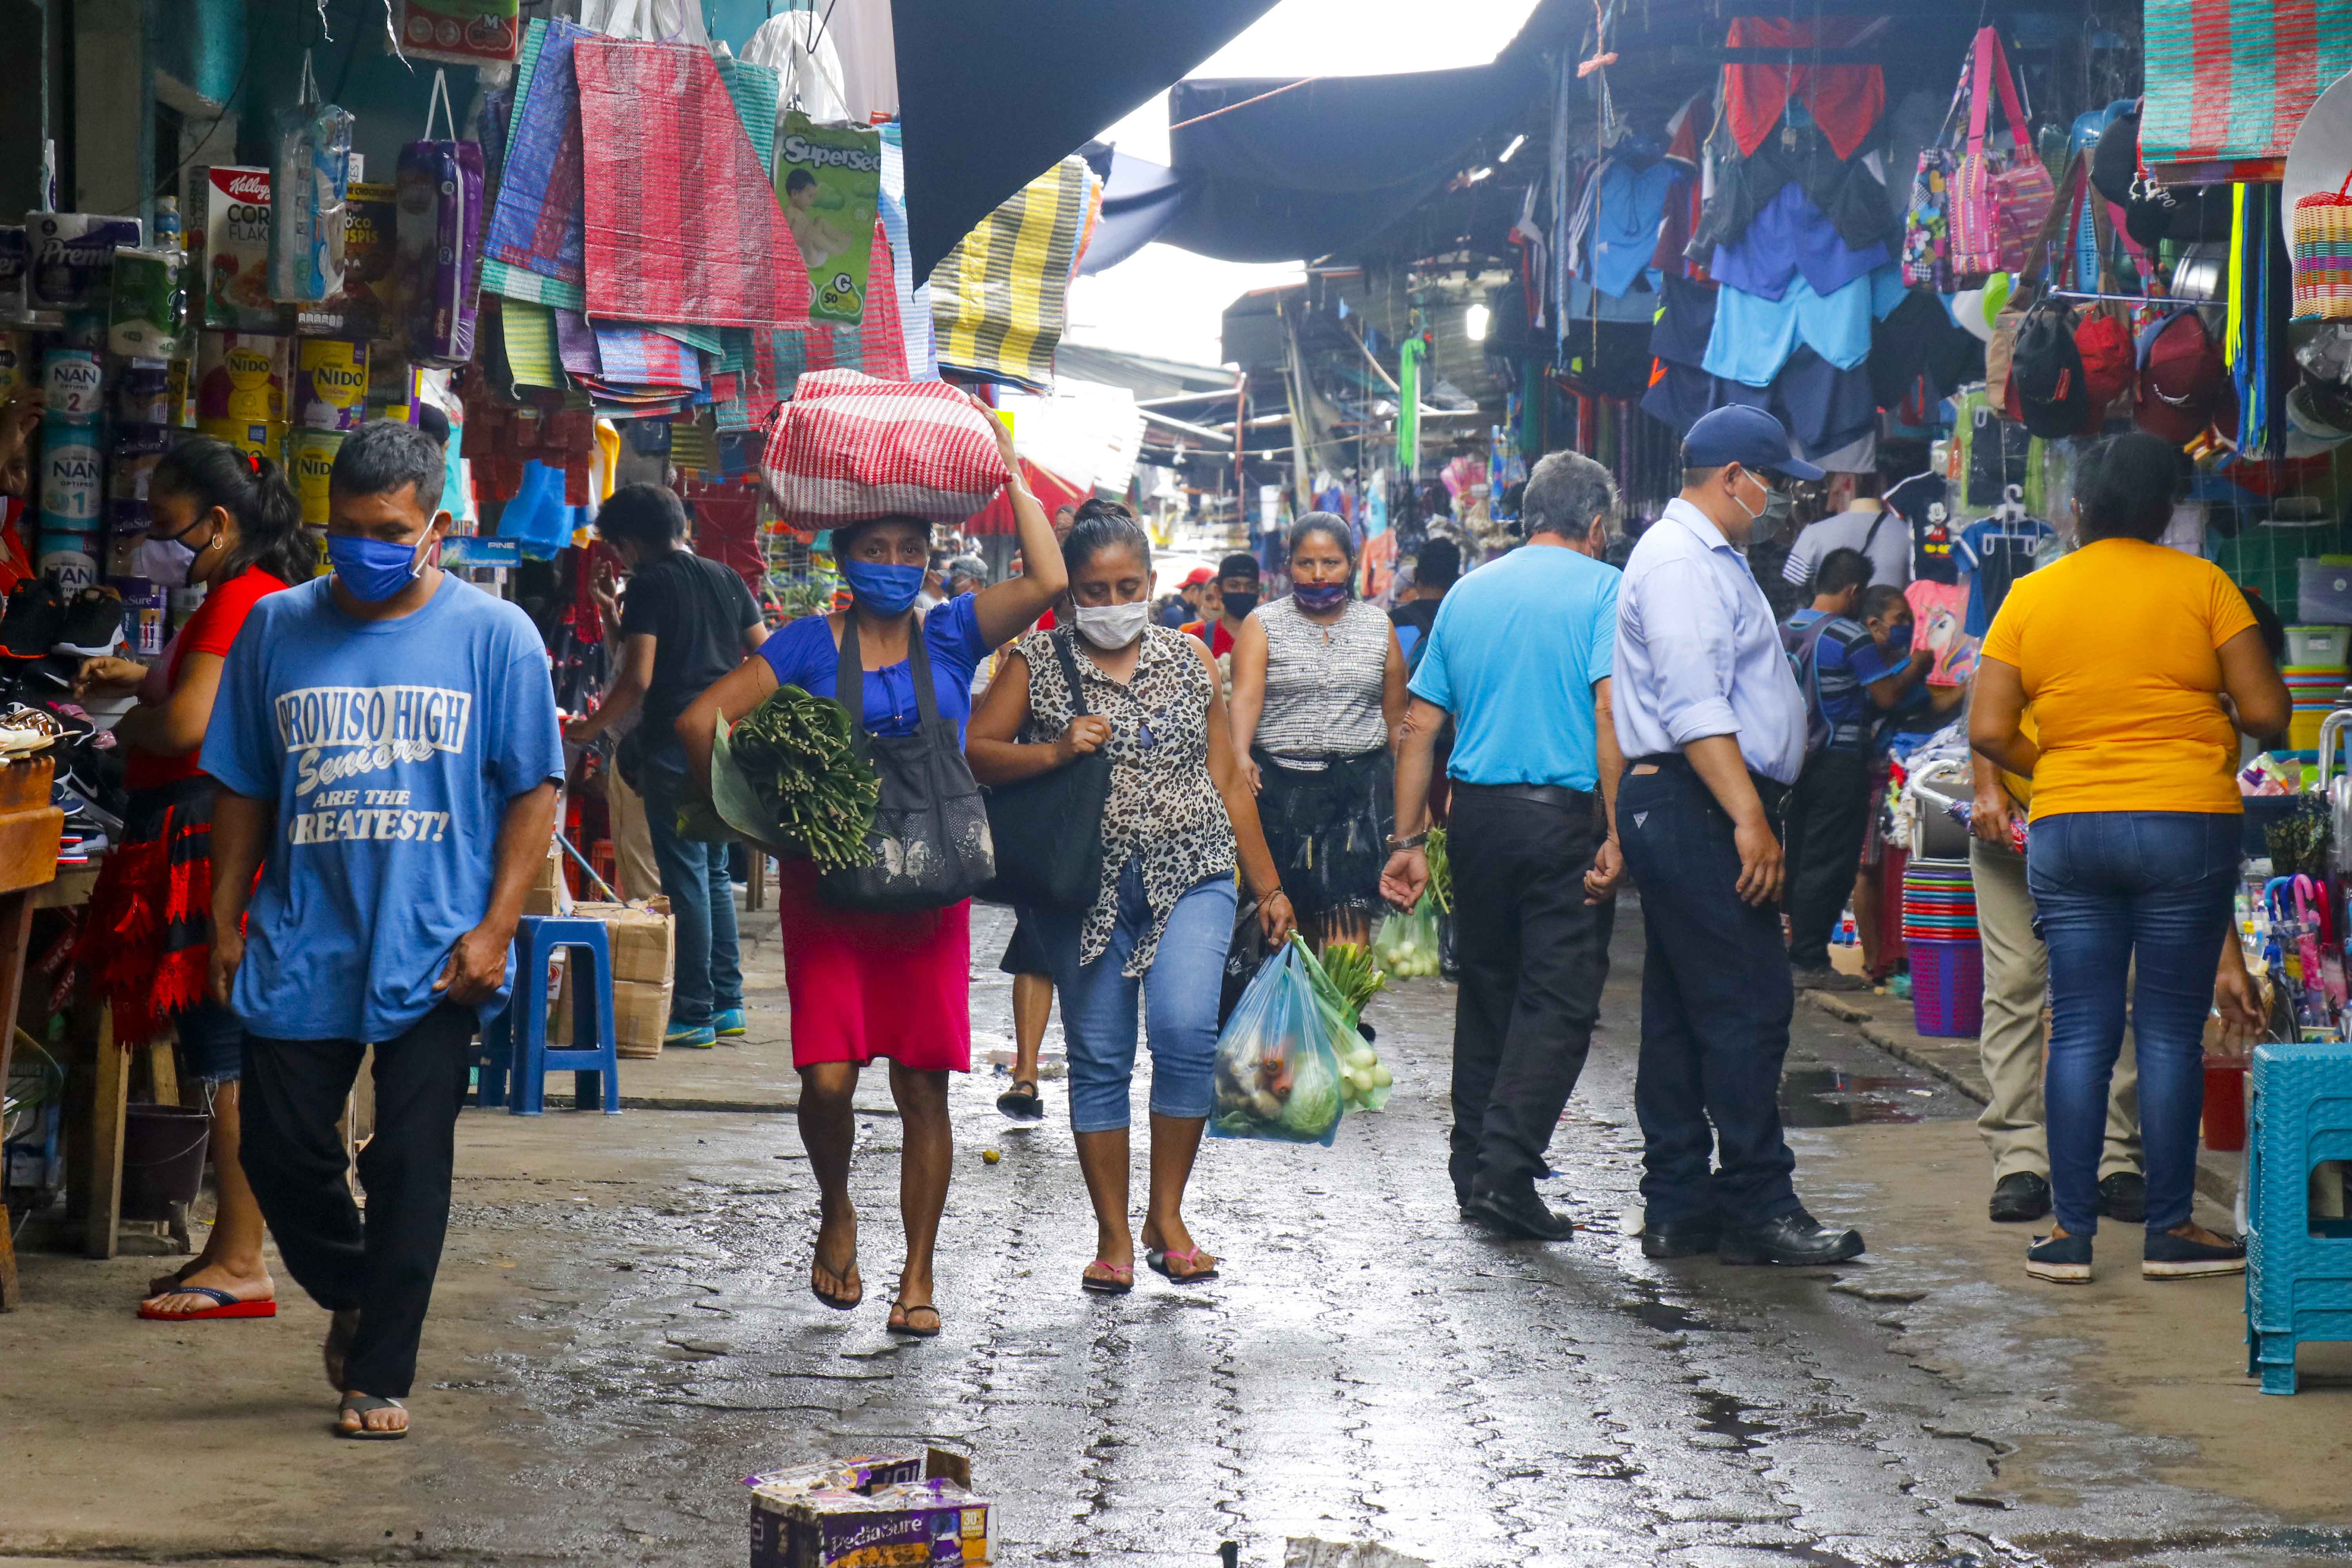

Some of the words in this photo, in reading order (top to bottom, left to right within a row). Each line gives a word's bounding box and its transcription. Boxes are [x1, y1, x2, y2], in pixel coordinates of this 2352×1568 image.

[483, 13, 500, 29] M
[229, 224, 270, 241] FLAK
[834, 273, 852, 293] G
[824, 292, 838, 303] 50
[230, 357, 269, 372] NIDO
[54, 367, 96, 383] NAN
[318, 368, 363, 387] NIDO
[68, 393, 80, 411] 2
[53, 461, 100, 478] NAN
[72, 492, 84, 513] 1
[279, 691, 385, 746] PROVISO
[393, 690, 464, 748] HIGH
[296, 737, 434, 797] Seniors
[313, 789, 359, 808] ARE
[364, 789, 410, 806] THE
[831, 1517, 923, 1557] PediaSure
